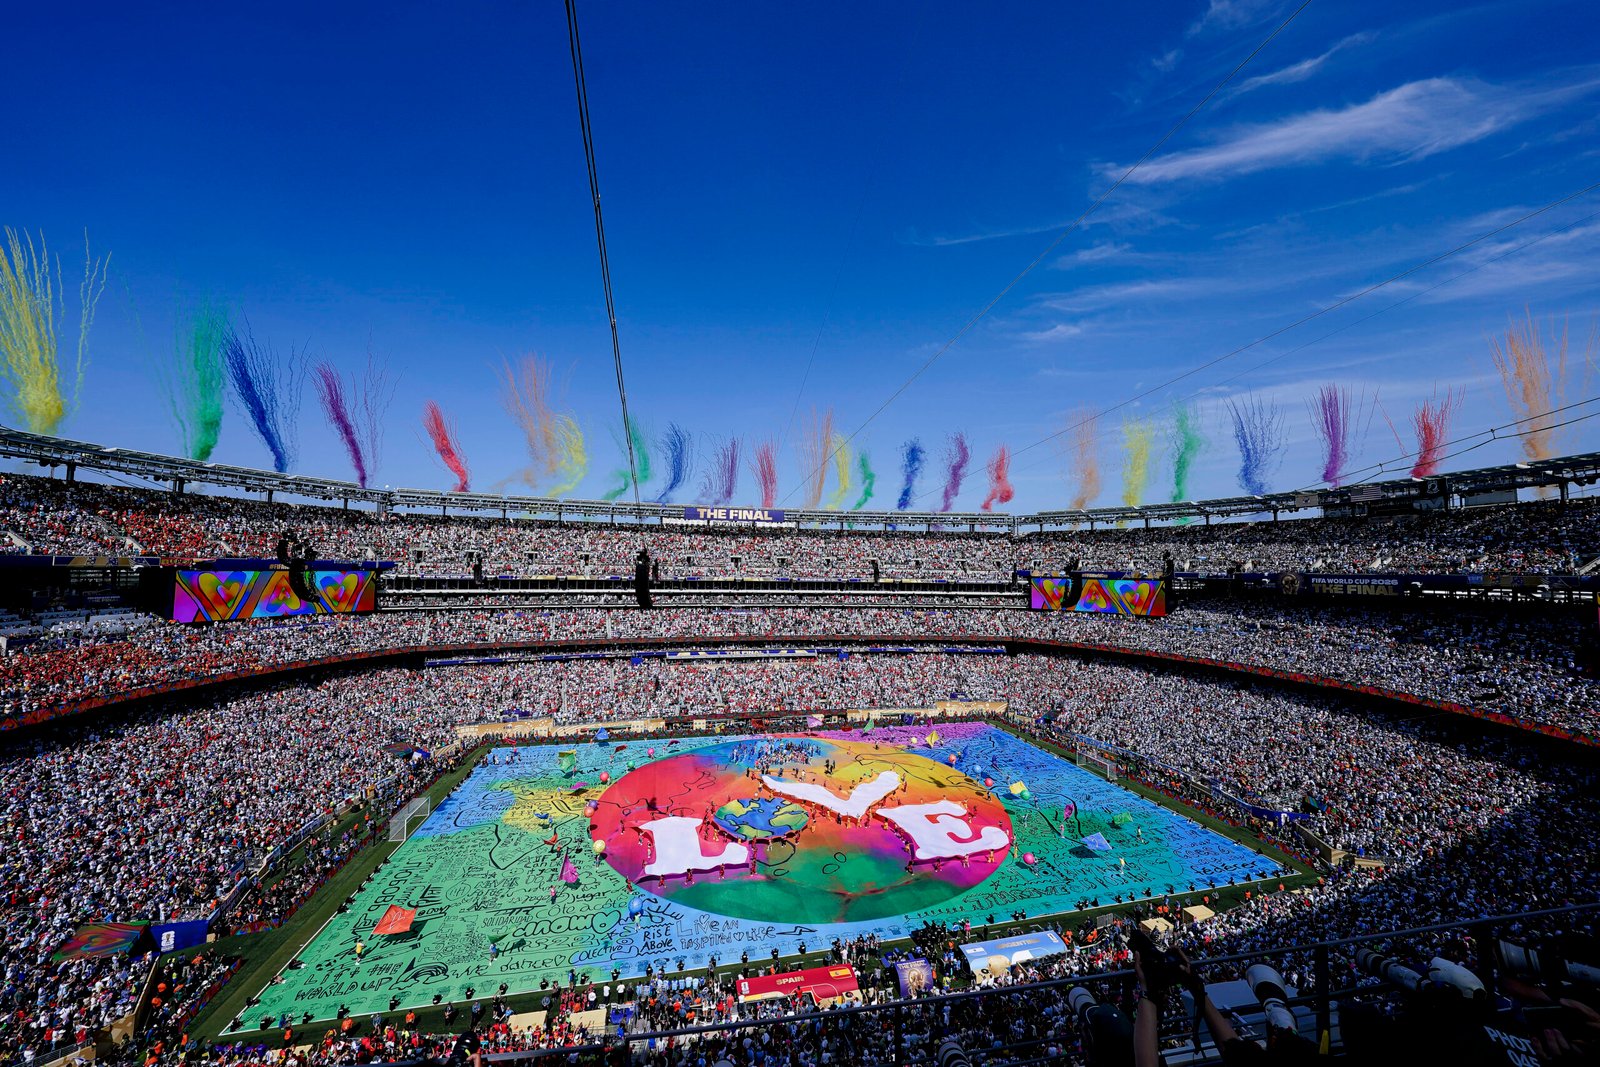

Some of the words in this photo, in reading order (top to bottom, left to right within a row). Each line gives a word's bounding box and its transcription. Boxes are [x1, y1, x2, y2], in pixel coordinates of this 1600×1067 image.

[697, 508, 727, 519] THE
[729, 510, 772, 520] FINAL
[1312, 584, 1343, 594] THE
[1347, 584, 1398, 595] FINAL
[481, 916, 534, 928] SOLIDARIDAD
[776, 975, 805, 986] SPAIN
[1483, 1025, 1537, 1055] PHOT
